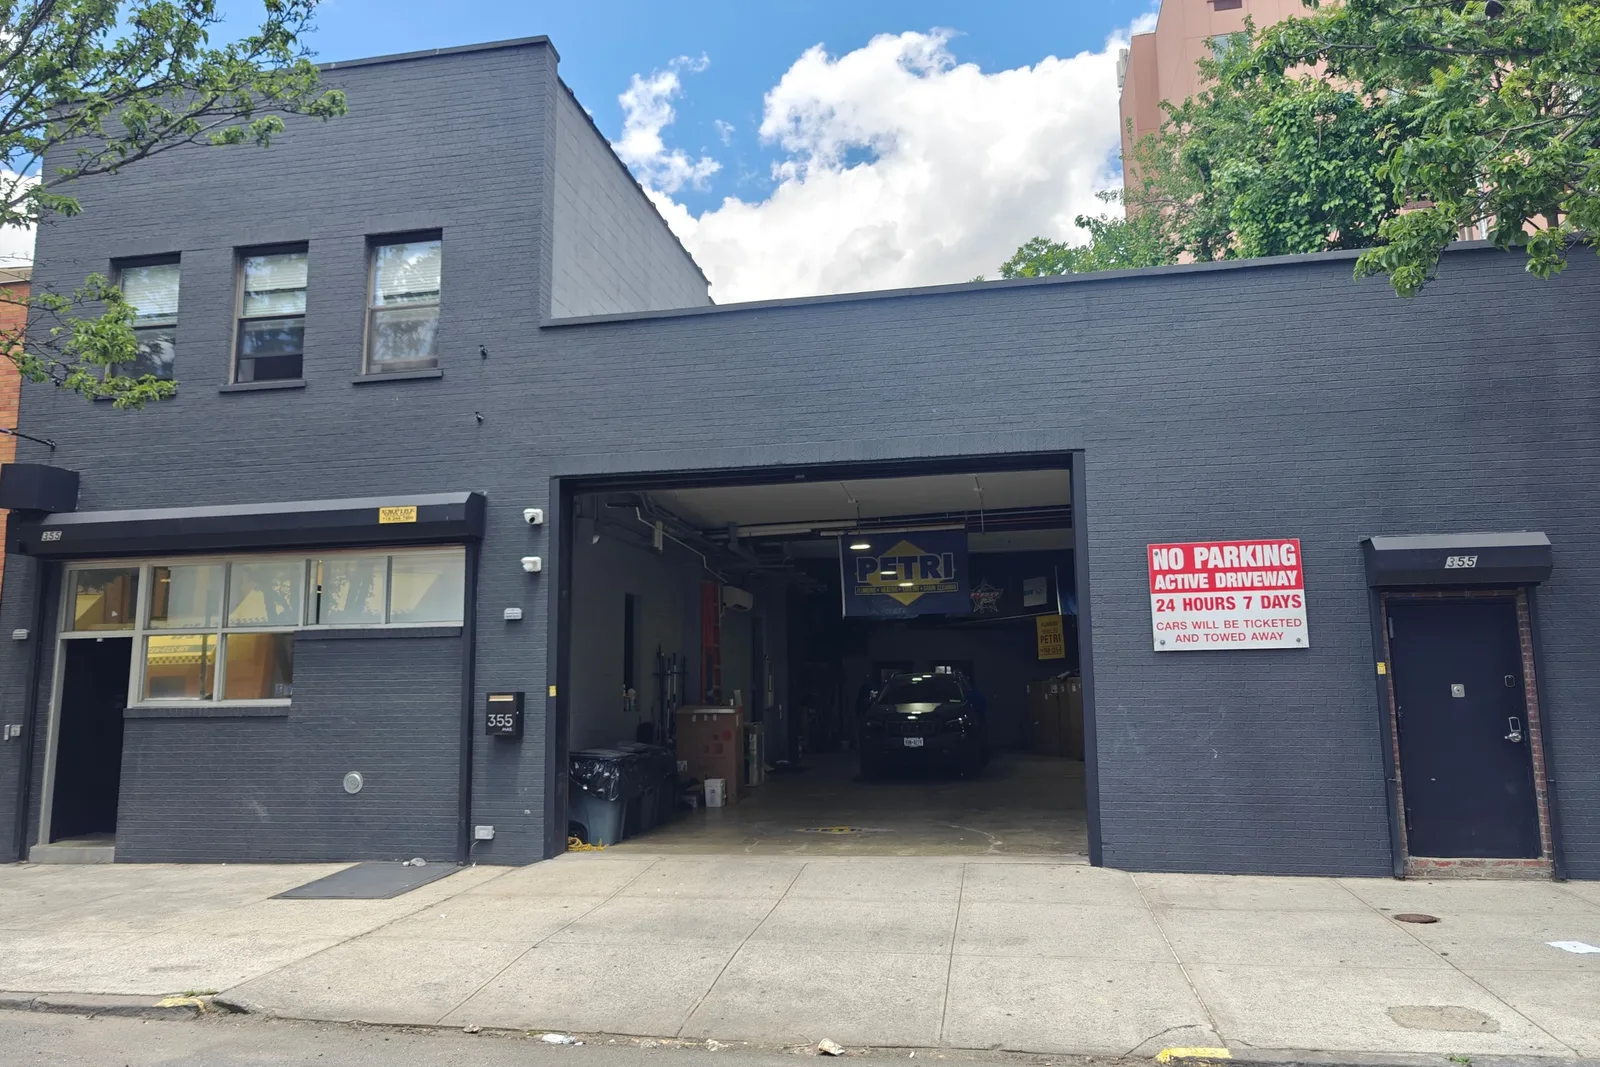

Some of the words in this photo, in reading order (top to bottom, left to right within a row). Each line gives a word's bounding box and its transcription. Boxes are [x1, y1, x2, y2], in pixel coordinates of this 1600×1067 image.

[43, 531, 61, 540] 355
[1152, 548, 1184, 570] NO
[1193, 543, 1297, 569] PARKING
[1447, 556, 1476, 568] 355
[856, 552, 954, 583] PETRI
[1155, 573, 1209, 590] ACTIVE
[1215, 570, 1298, 588] DRIVEWAY
[1156, 599, 1176, 612] 24
[1183, 596, 1236, 611] HOURS
[1243, 596, 1253, 610] 7
[1261, 594, 1302, 609] DAYS
[1156, 621, 1187, 631] CARS
[1192, 620, 1219, 630] WILL
[1224, 620, 1239, 629] BE
[1243, 618, 1302, 628] TICKETED
[1040, 633, 1061, 645] PETRI
[1175, 634, 1199, 643] AND
[1204, 632, 1246, 642] TOWED
[1251, 631, 1284, 641] AWAY
[487, 714, 513, 727] 355
